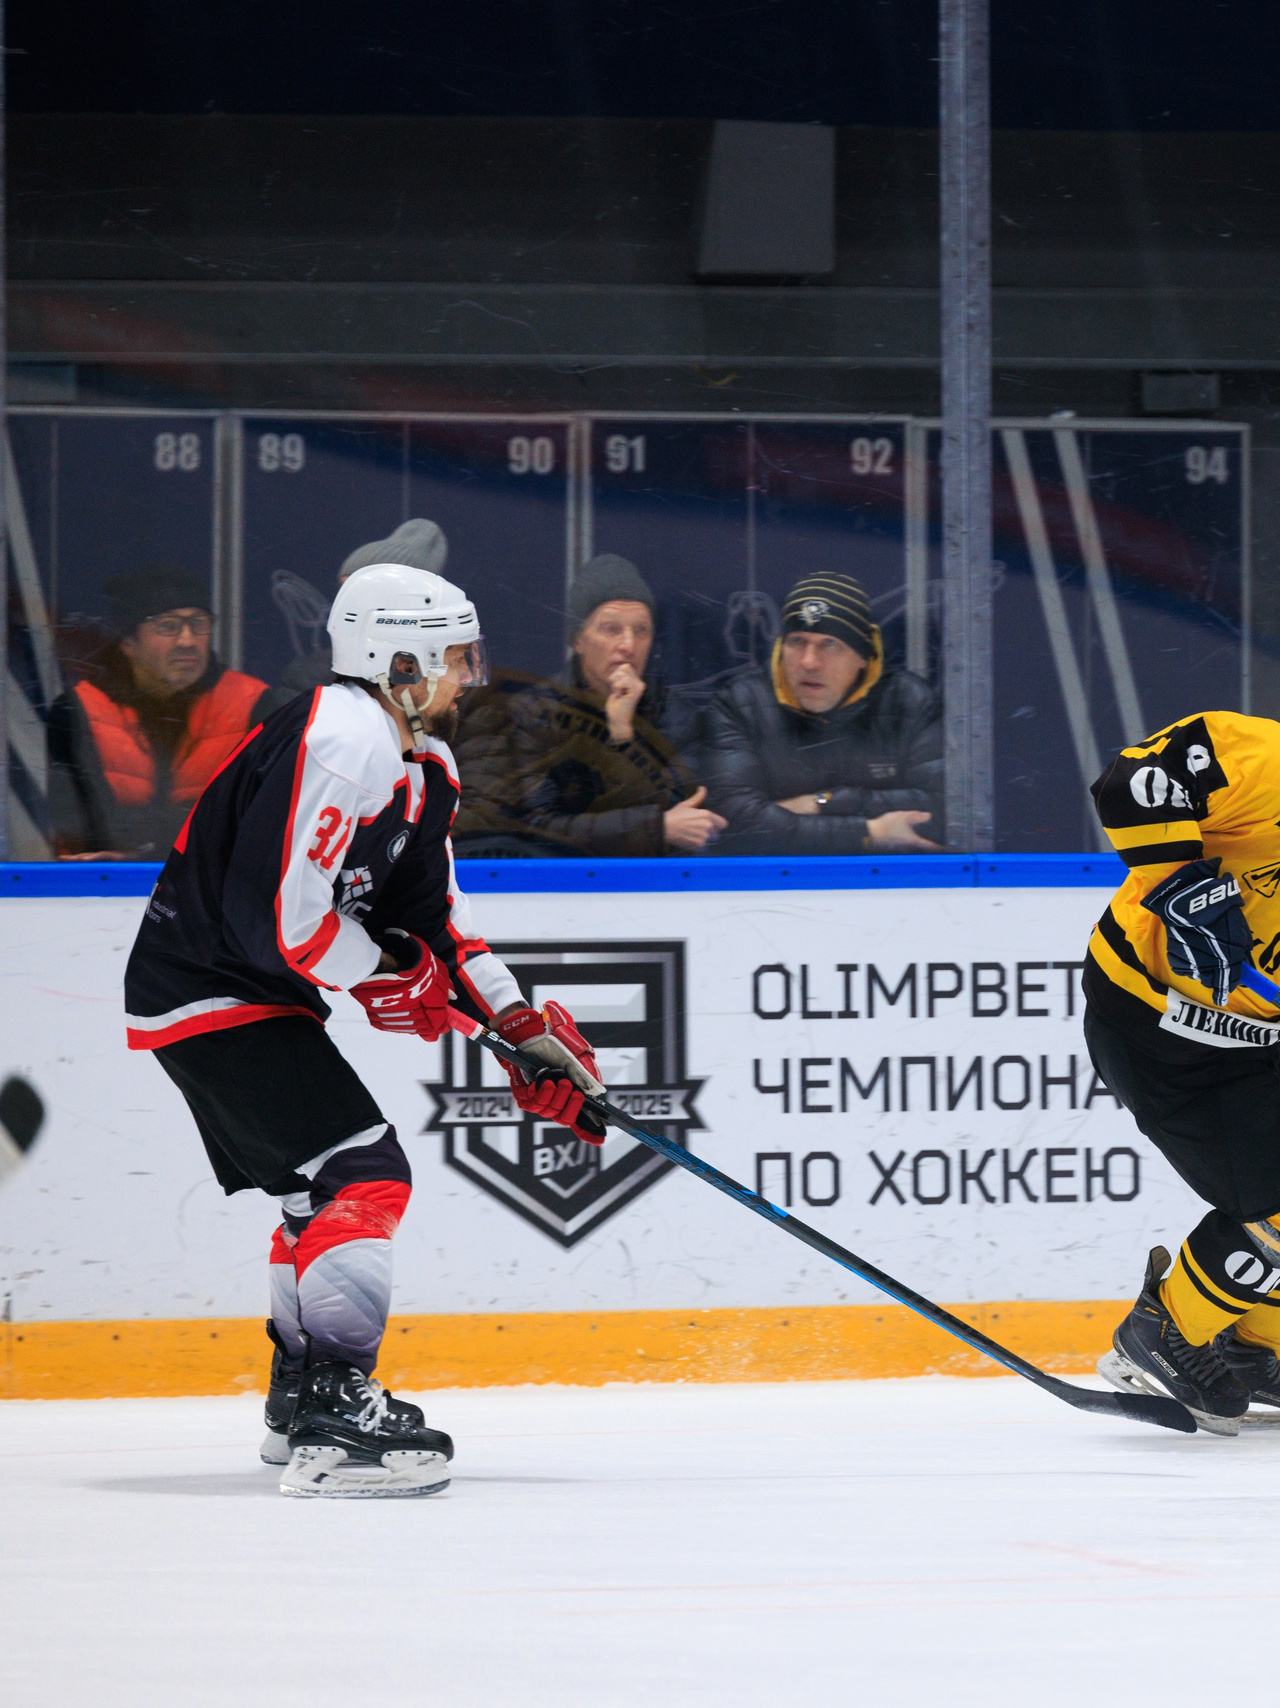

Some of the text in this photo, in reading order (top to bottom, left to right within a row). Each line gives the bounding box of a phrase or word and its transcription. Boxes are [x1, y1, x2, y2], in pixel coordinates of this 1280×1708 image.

[154, 432, 200, 471] 88
[257, 432, 304, 471] 89
[507, 435, 555, 475] 90
[606, 434, 647, 473] 91
[851, 437, 894, 475] 92
[1185, 445, 1229, 485] 94
[306, 805, 353, 871] 31
[752, 960, 1086, 1020] OLIMPBET
[502, 1014, 530, 1032] CCM
[752, 1053, 1125, 1114] ЧЕМПИОНА
[457, 1096, 513, 1118] 2024
[616, 1093, 672, 1116] 2025
[755, 1150, 841, 1208] ПО
[868, 1146, 1141, 1206] ХОККЕЮ
